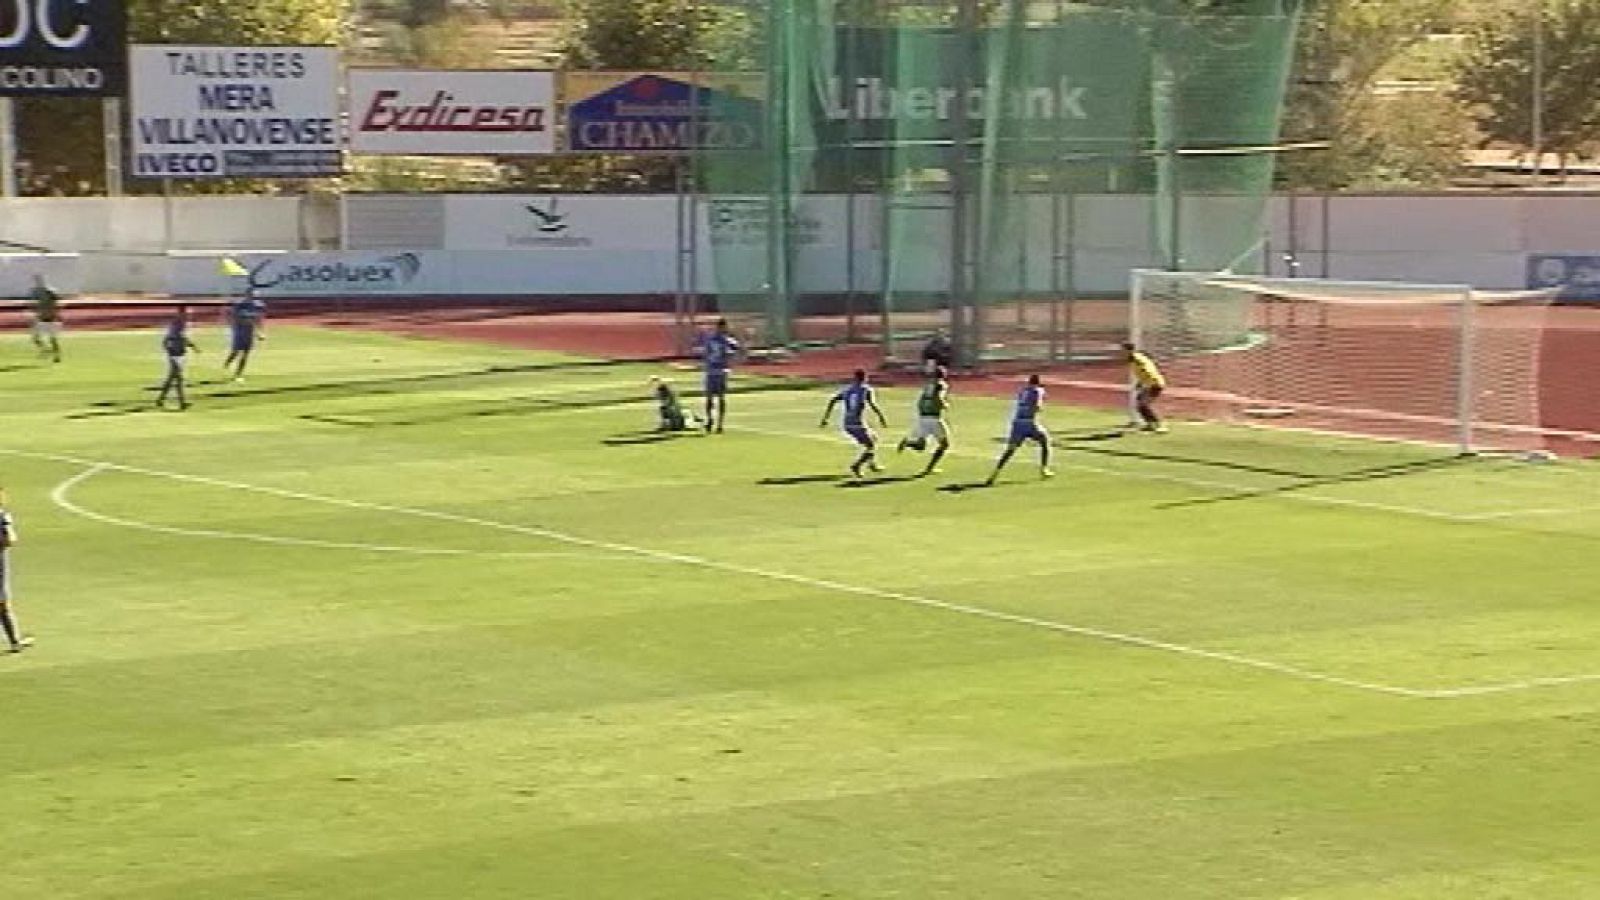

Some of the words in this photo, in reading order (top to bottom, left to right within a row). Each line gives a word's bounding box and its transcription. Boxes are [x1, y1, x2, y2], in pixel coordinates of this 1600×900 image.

[165, 51, 306, 78] TALLERES
[198, 86, 275, 110] MERA
[137, 118, 336, 145] VILLANOVENSE
[137, 153, 217, 173] IVECO
